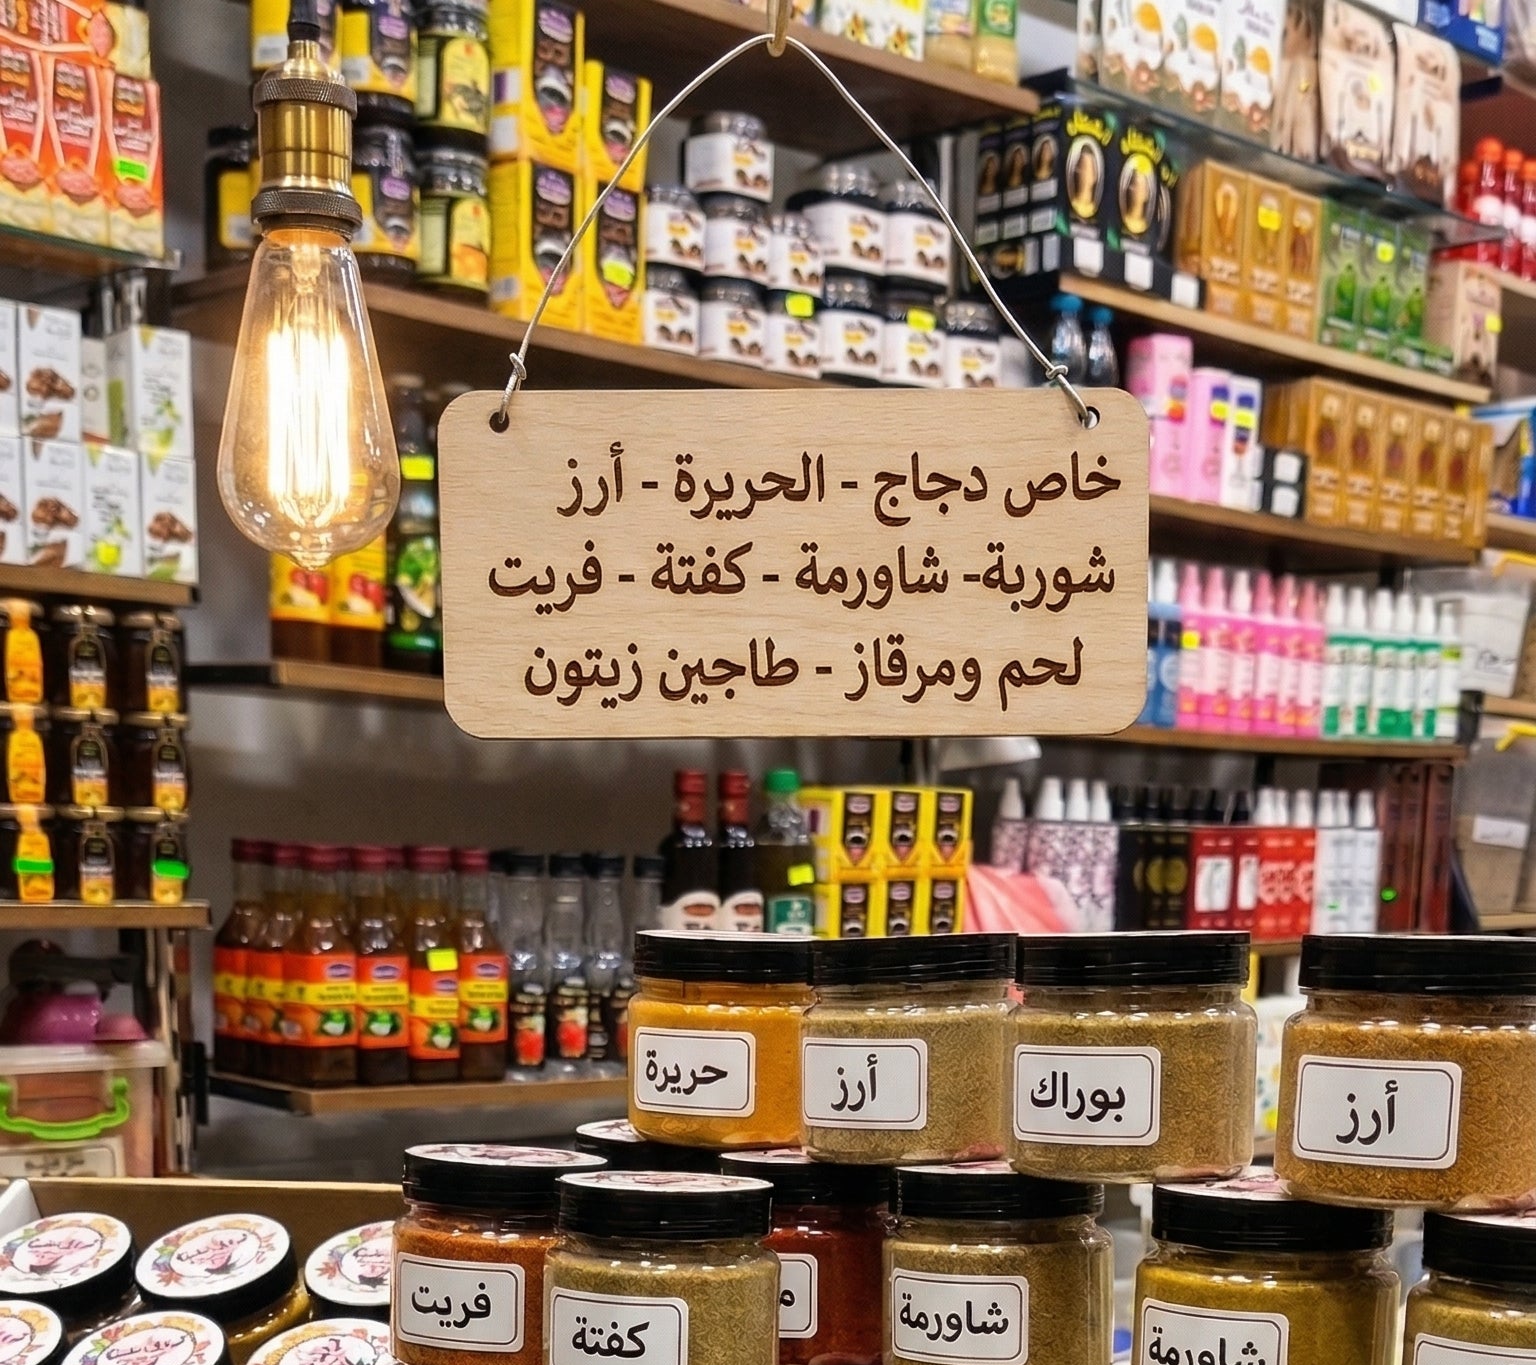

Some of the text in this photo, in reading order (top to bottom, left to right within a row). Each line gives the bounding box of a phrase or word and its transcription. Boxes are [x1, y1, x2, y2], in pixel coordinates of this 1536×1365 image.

[556, 440, 625, 518] أرز
[674, 450, 825, 521] الحريرة
[873, 451, 988, 528] دجاج
[1003, 450, 1122, 518] خاص
[488, 539, 603, 616] فريت
[651, 541, 754, 595] كفتة
[795, 541, 949, 610] شاورمة
[524, 642, 643, 710] زيتون
[658, 636, 800, 705] طاجين
[844, 633, 982, 704] ومرقاز
[998, 636, 1084, 712] لحم
[645, 1050, 728, 1096] حريرة
[830, 1053, 878, 1112] أرز
[1030, 1070, 1126, 1123] بوراك
[1335, 1079, 1399, 1146] أرز
[411, 1282, 492, 1329] فريت
[571, 1316, 650, 1359] كفتة
[899, 1292, 1009, 1343] شاورمة
